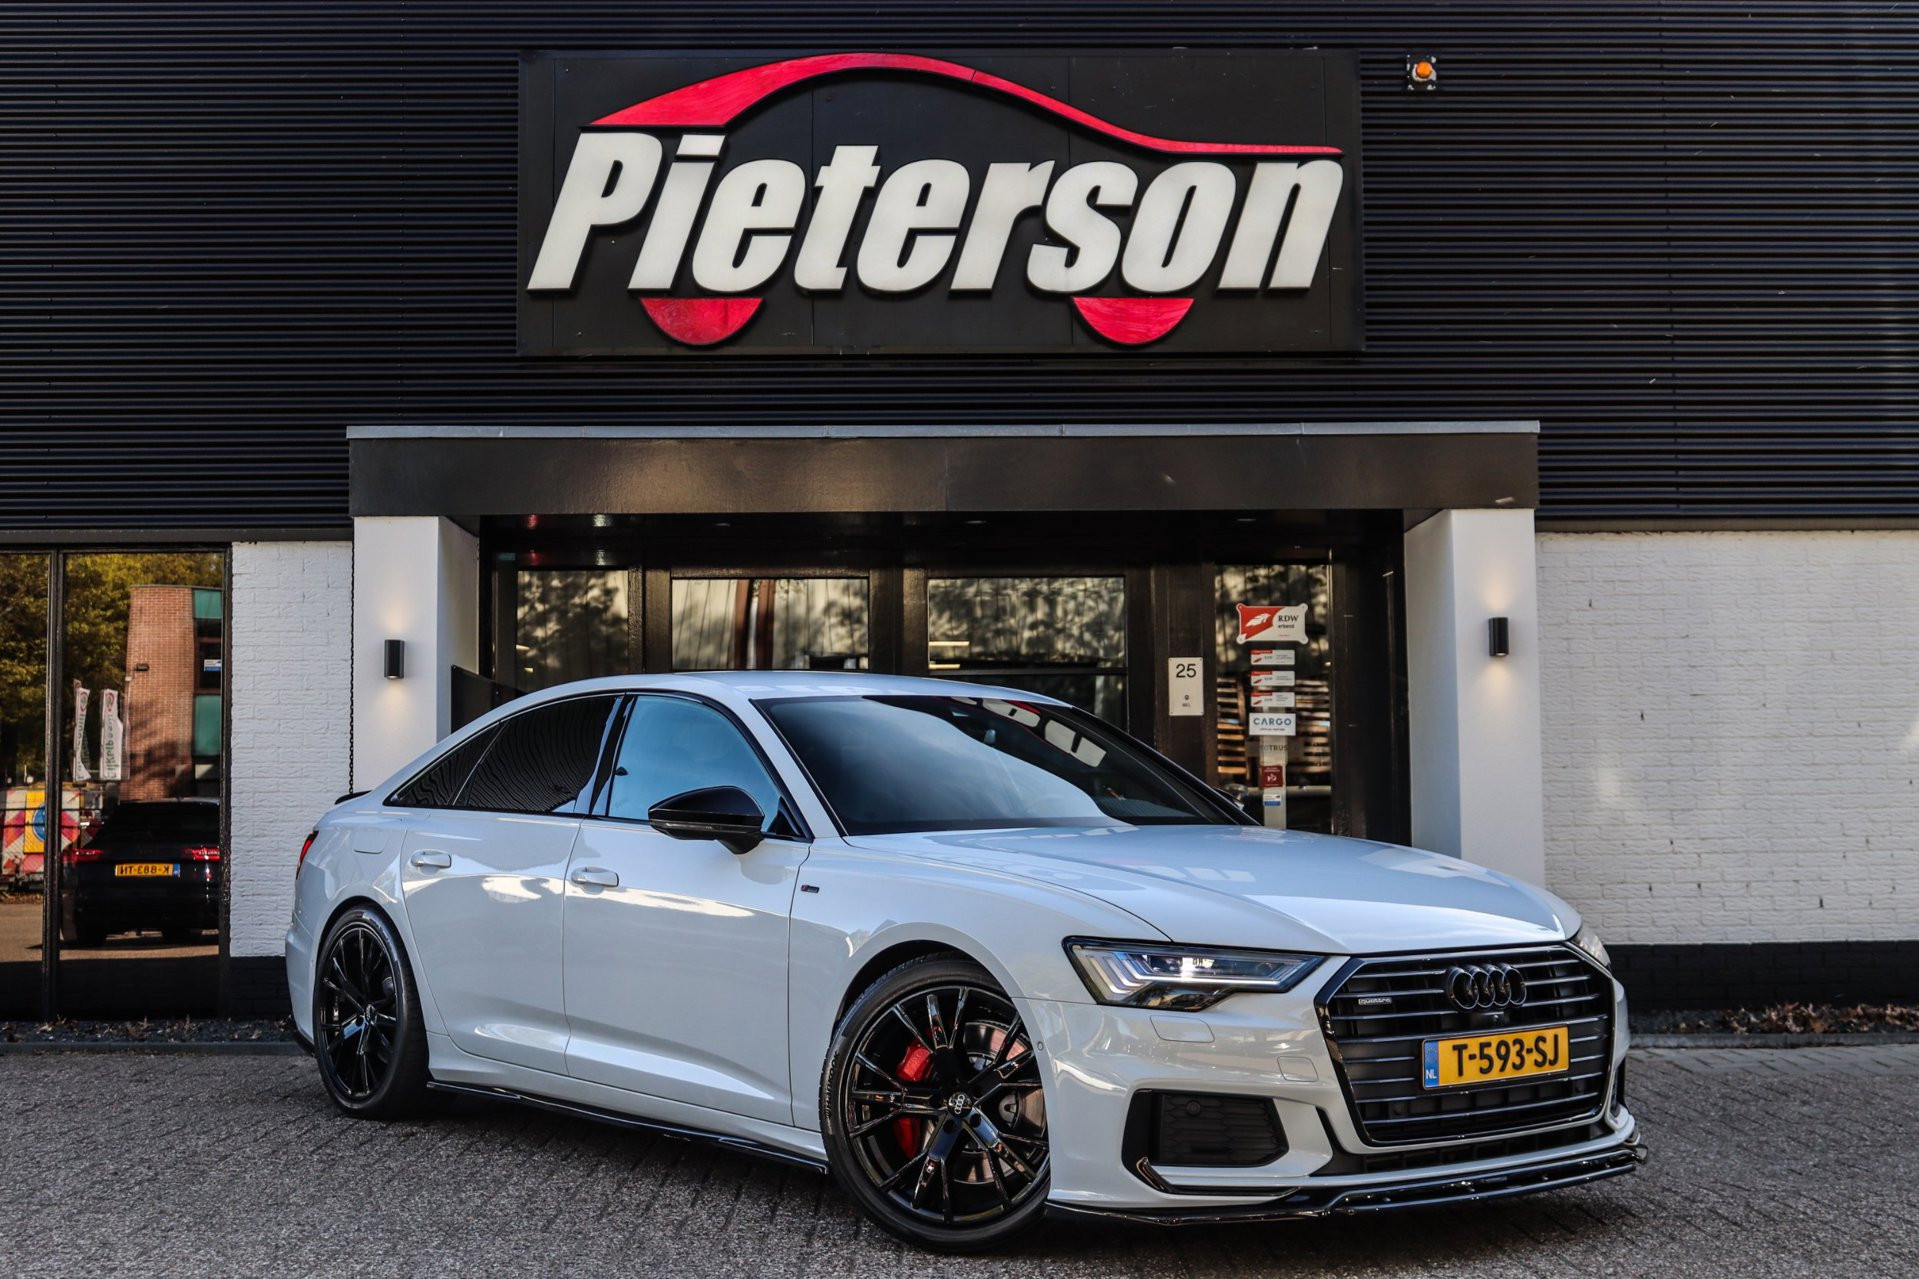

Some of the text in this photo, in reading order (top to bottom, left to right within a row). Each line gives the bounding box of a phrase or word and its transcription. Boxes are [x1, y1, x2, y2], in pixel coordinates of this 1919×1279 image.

[527, 133, 1344, 293] Pieterson
[1278, 615, 1299, 623] RDW
[1176, 663, 1197, 679] 25
[1253, 717, 1292, 726] CARGO
[1452, 1034, 1559, 1077] T-593-SJ
[1426, 1069, 1438, 1079] NL
